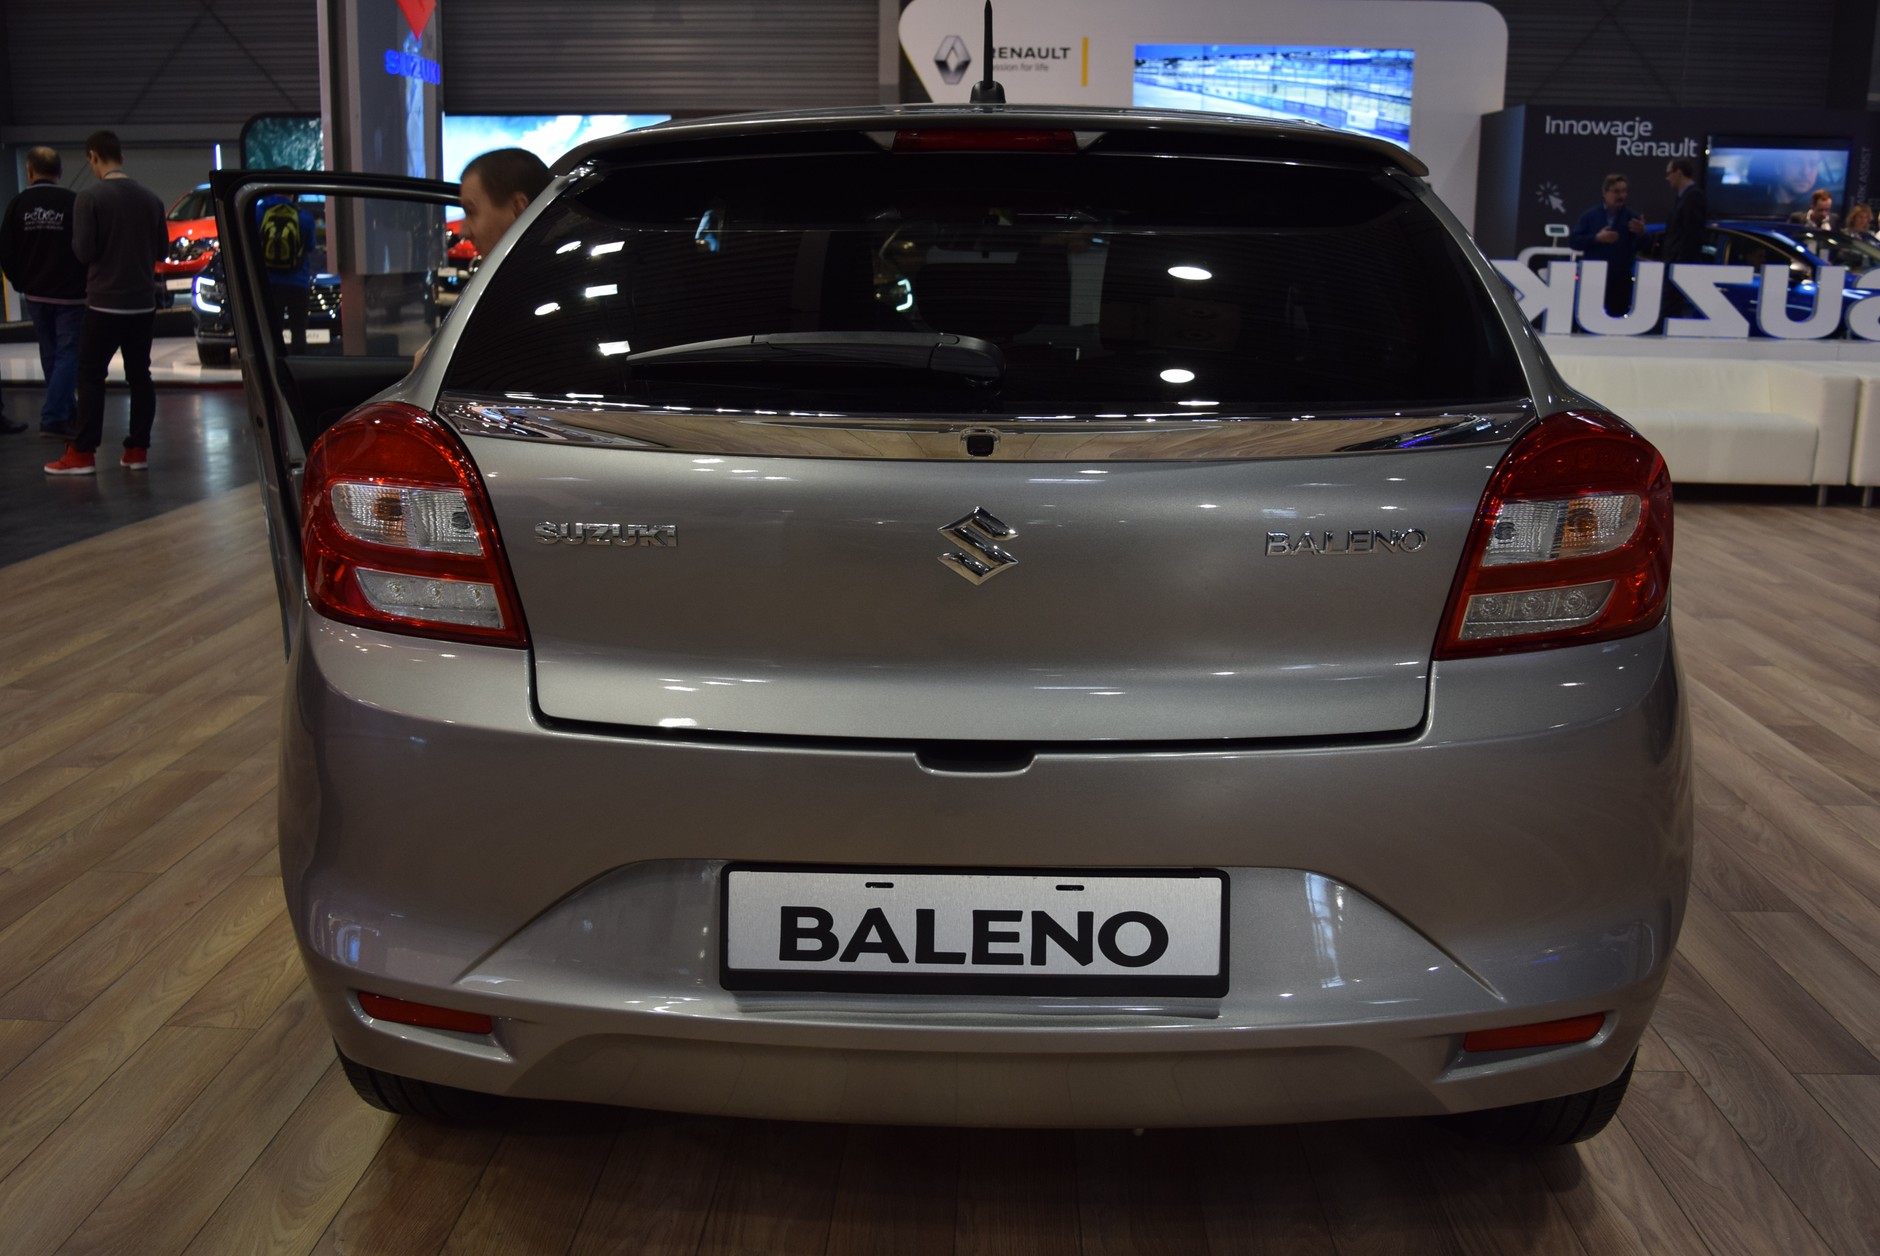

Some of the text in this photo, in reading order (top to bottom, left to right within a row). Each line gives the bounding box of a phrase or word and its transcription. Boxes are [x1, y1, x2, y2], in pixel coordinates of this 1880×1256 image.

[1020, 61, 1033, 72] for
[1034, 61, 1049, 72] life
[1545, 115, 1653, 140] Innowacje
[1616, 137, 1699, 157] Renault
[535, 521, 677, 547] SUZUKI
[1265, 528, 1428, 556] BALENO
[779, 905, 1169, 968] BALENO
